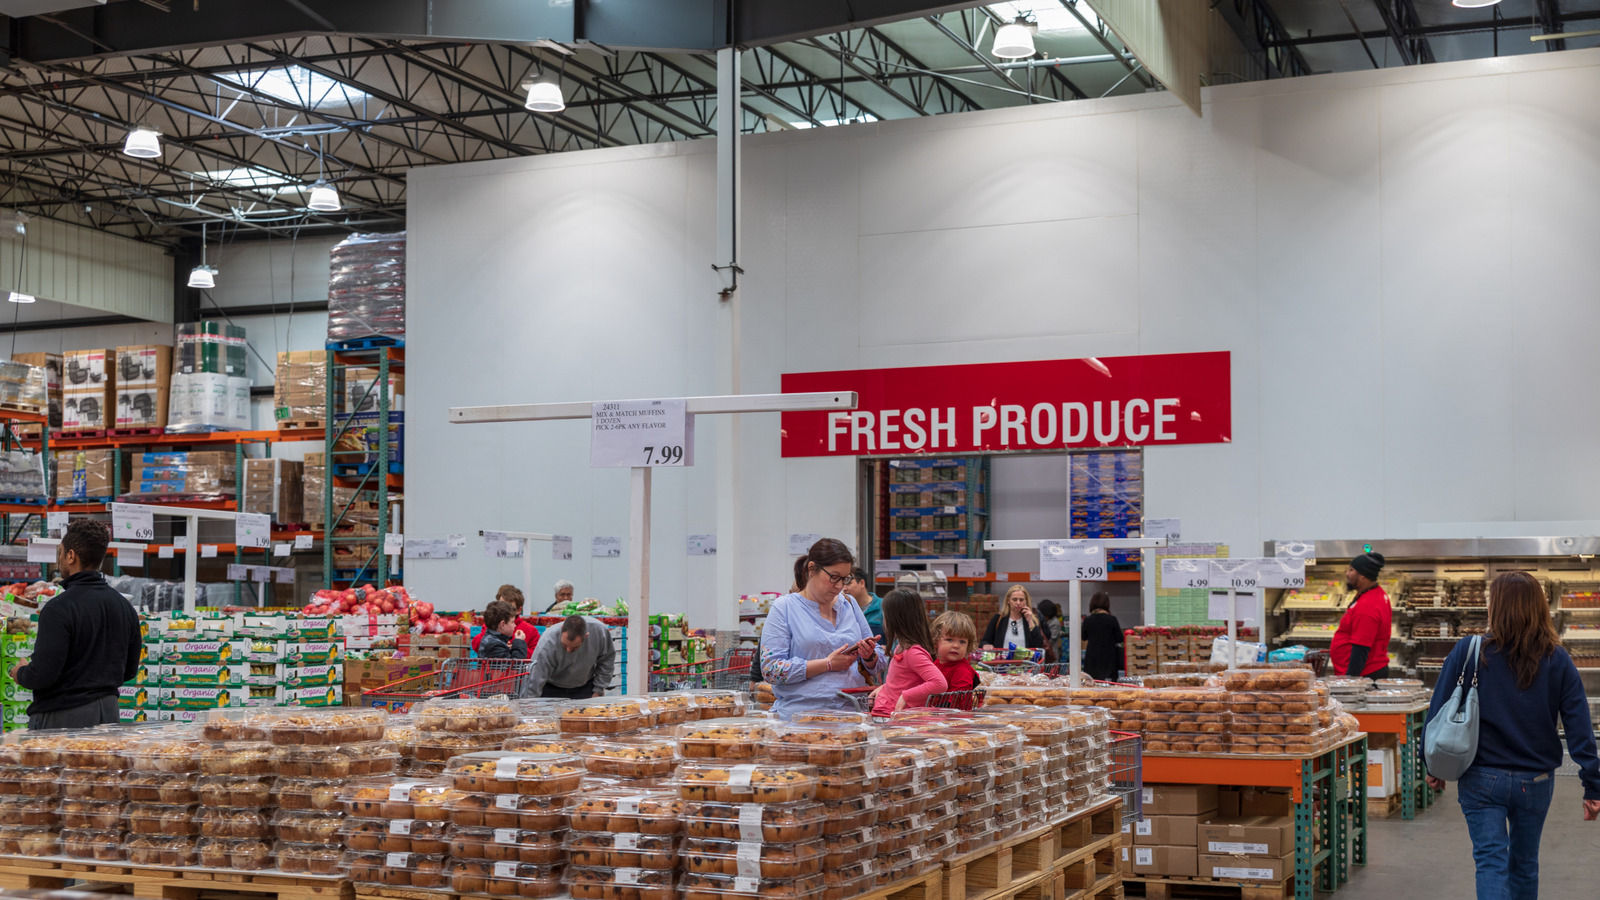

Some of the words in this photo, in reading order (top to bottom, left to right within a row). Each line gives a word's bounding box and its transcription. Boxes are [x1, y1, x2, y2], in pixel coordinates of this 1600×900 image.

[827, 407, 956, 451] FRESH
[972, 398, 1178, 447] PRODUCE
[643, 445, 683, 465] 7.99
[136, 529, 152, 539] 6.99
[255, 537, 270, 547] 1.99
[1076, 567, 1103, 578] 5.99
[1188, 579, 1208, 588] 4.99
[1231, 579, 1256, 588] 10.99
[1284, 578, 1304, 586] 9.99
[303, 620, 326, 629] Organic
[184, 642, 218, 652] Organic
[304, 644, 328, 652] Organic
[184, 666, 216, 675] Organic
[303, 667, 326, 676] Organic
[182, 688, 216, 698] Organic
[302, 688, 326, 698] Organic
[182, 712, 196, 721] Org
